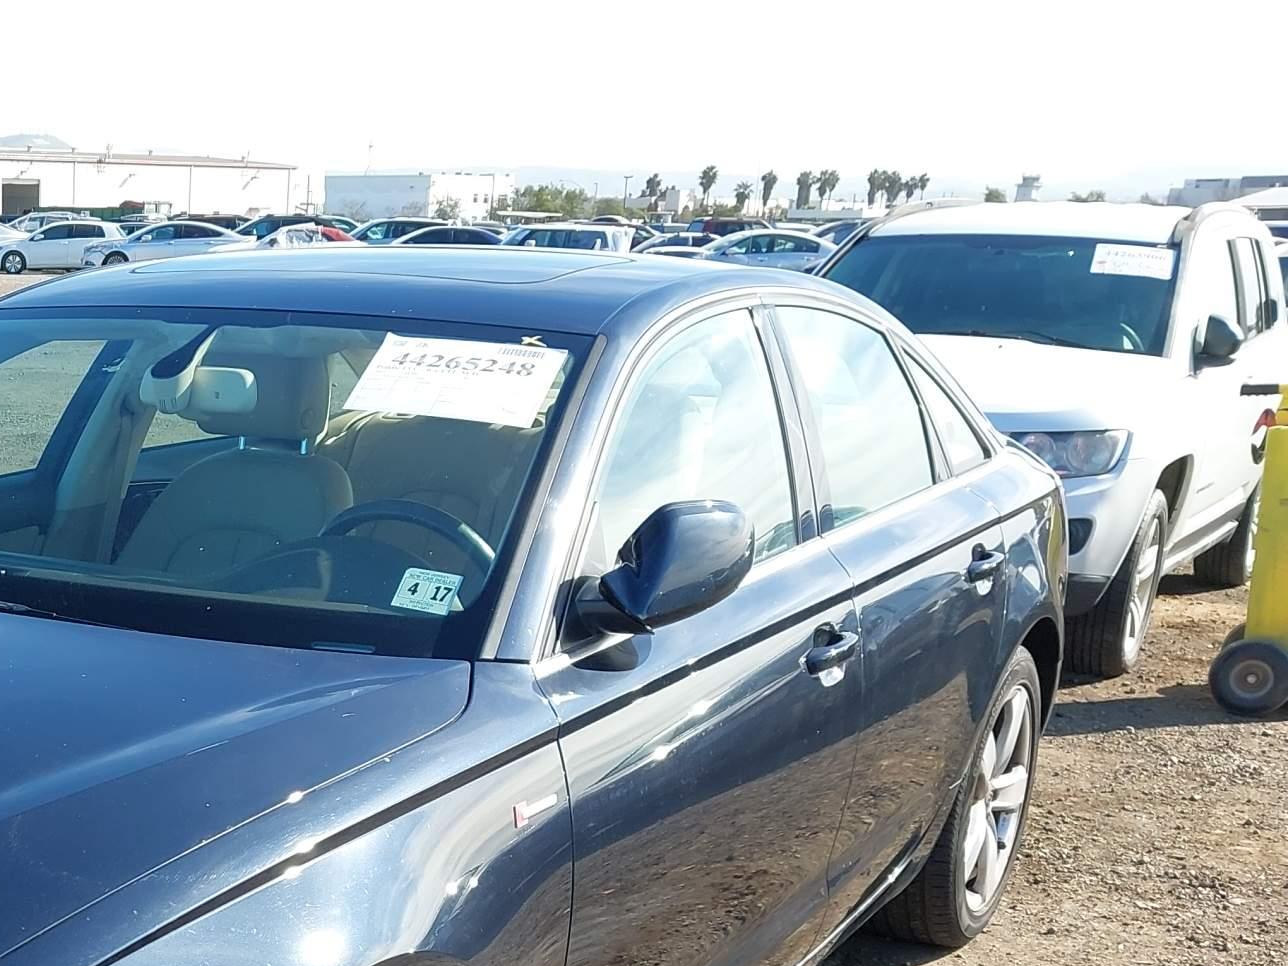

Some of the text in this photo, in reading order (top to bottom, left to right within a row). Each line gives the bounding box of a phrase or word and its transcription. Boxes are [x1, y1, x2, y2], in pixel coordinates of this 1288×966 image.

[391, 352, 536, 377] 44265248
[408, 582, 453, 602] 4 17
